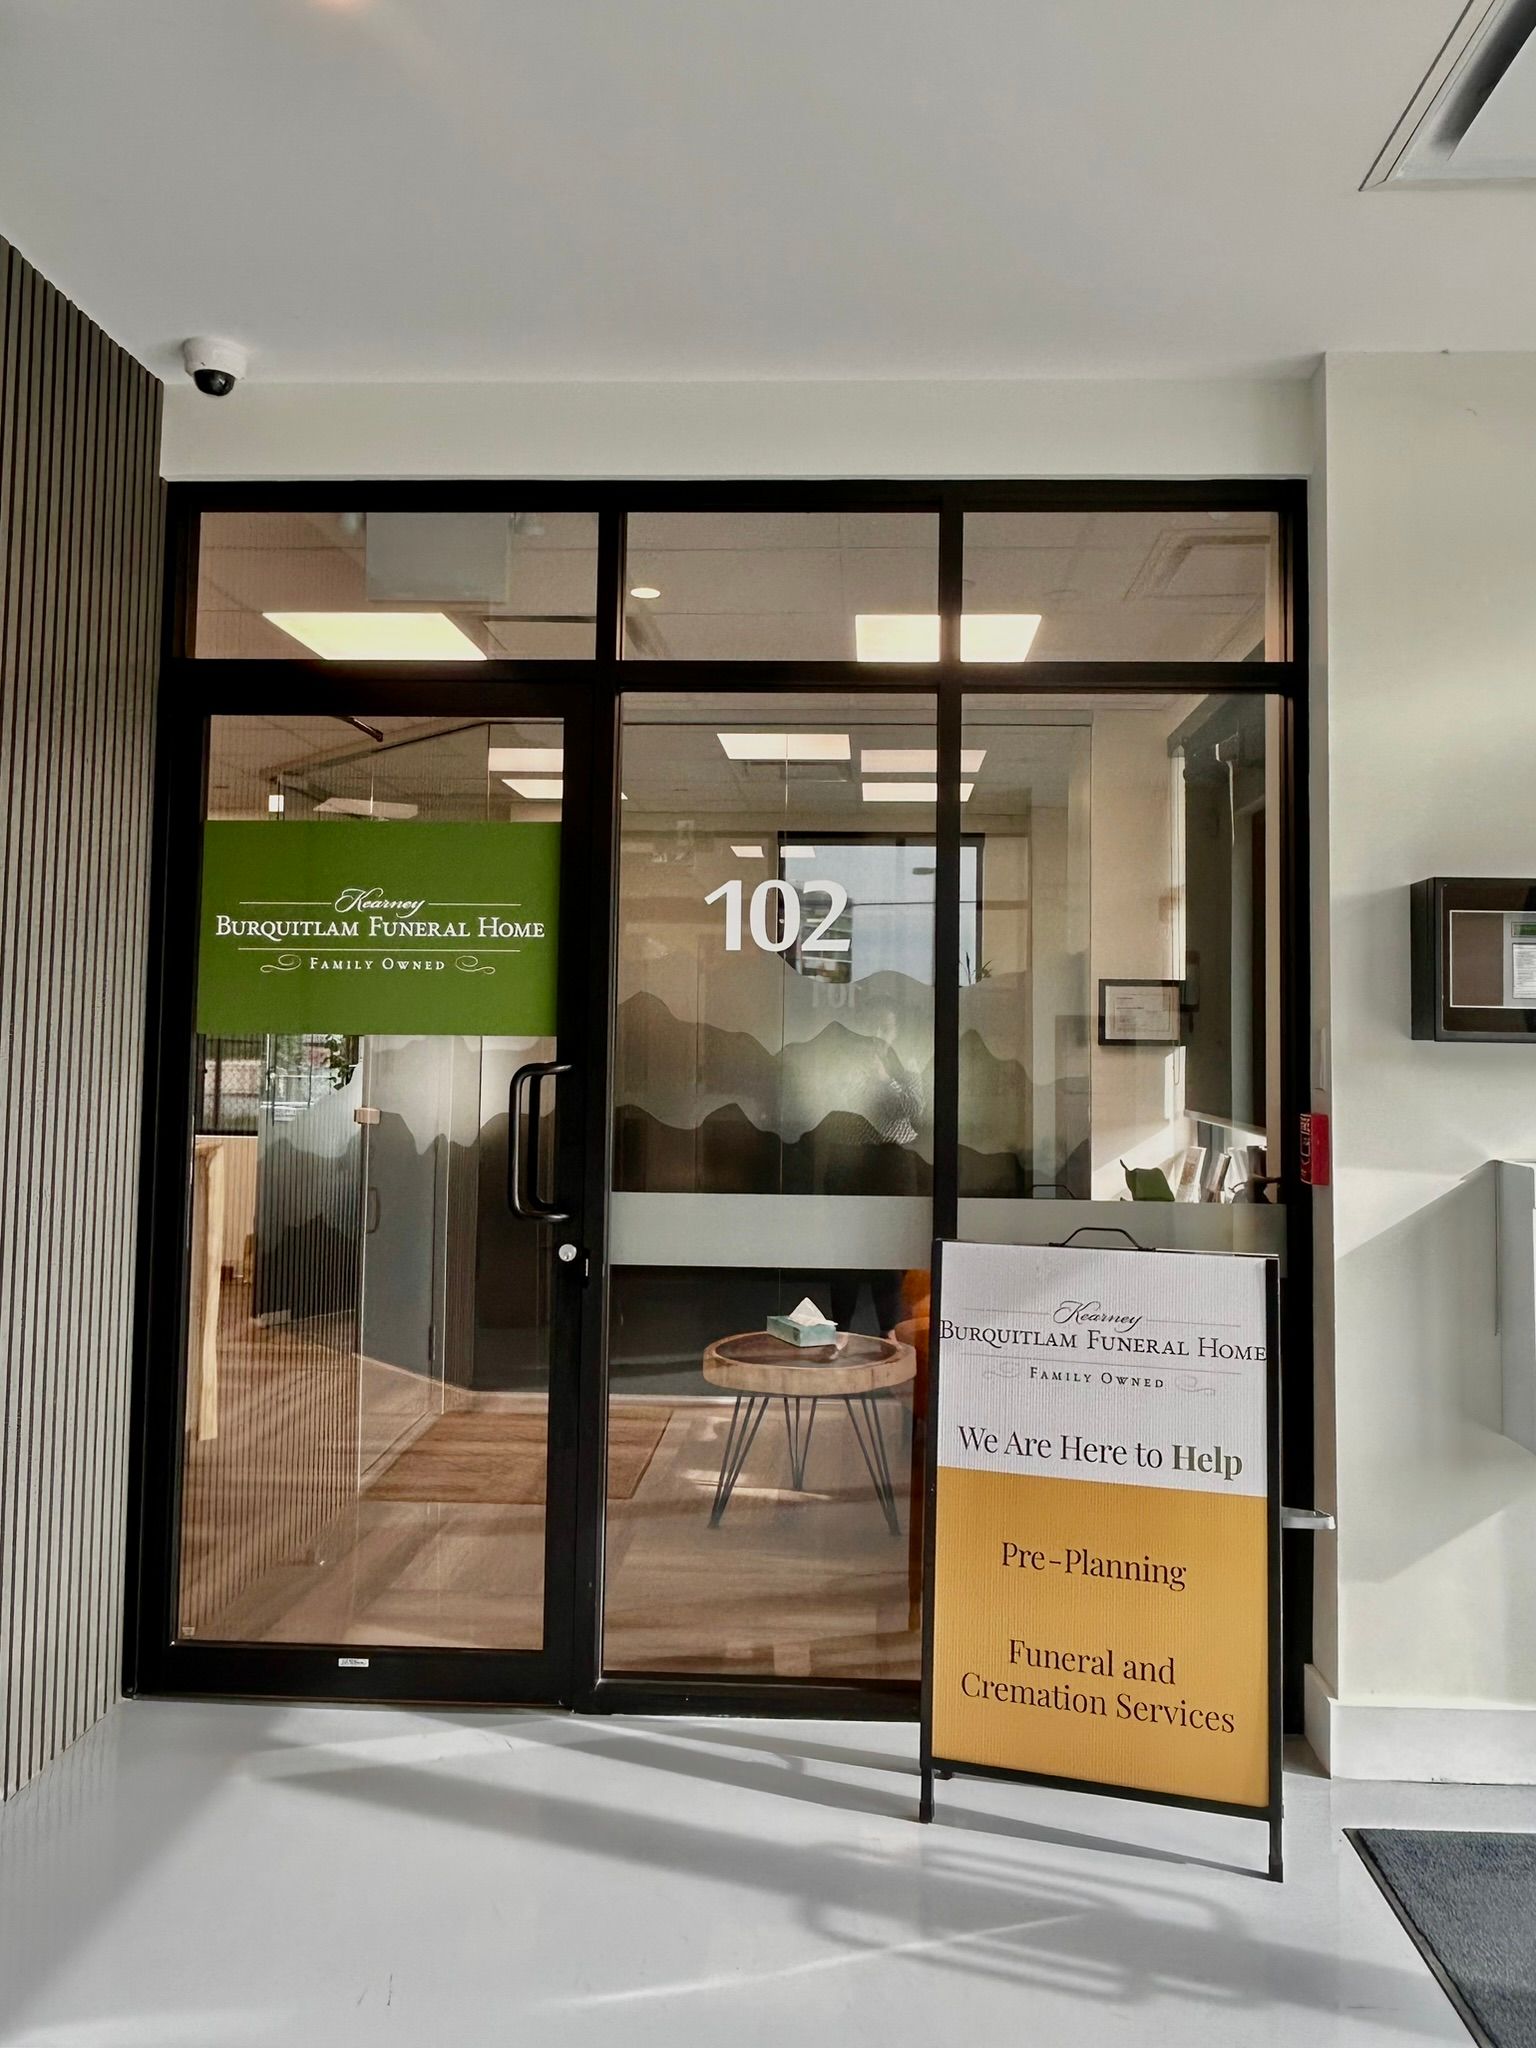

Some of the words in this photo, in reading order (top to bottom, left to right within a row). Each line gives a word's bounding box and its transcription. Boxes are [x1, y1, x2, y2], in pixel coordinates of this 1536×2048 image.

[334, 887, 425, 918] Kearney
[704, 879, 852, 953] 102
[215, 915, 359, 942] BURQUITLAM
[368, 916, 470, 938] FUNERAL
[478, 917, 545, 938] HOME
[310, 957, 373, 970] FAMILY
[382, 957, 445, 971] OWNED
[1053, 1300, 1143, 1333] Kearney
[939, 1319, 1078, 1348] BURQUITLAM
[1087, 1330, 1190, 1356] FUNERAL
[1197, 1336, 1267, 1361] HOME
[1030, 1366, 1092, 1384] FAMILY
[1101, 1372, 1164, 1389] OWNED
[958, 1425, 998, 1454] We
[1004, 1431, 1052, 1459] Are
[1060, 1434, 1128, 1466] Here
[1136, 1441, 1163, 1469] to
[1171, 1444, 1243, 1481] Help
[1001, 1541, 1187, 1592] Pre-Planning
[1009, 1639, 1114, 1677] Funeral
[1123, 1657, 1176, 1685] and
[961, 1672, 1107, 1717] Cremation
[1116, 1693, 1235, 1734] Services
